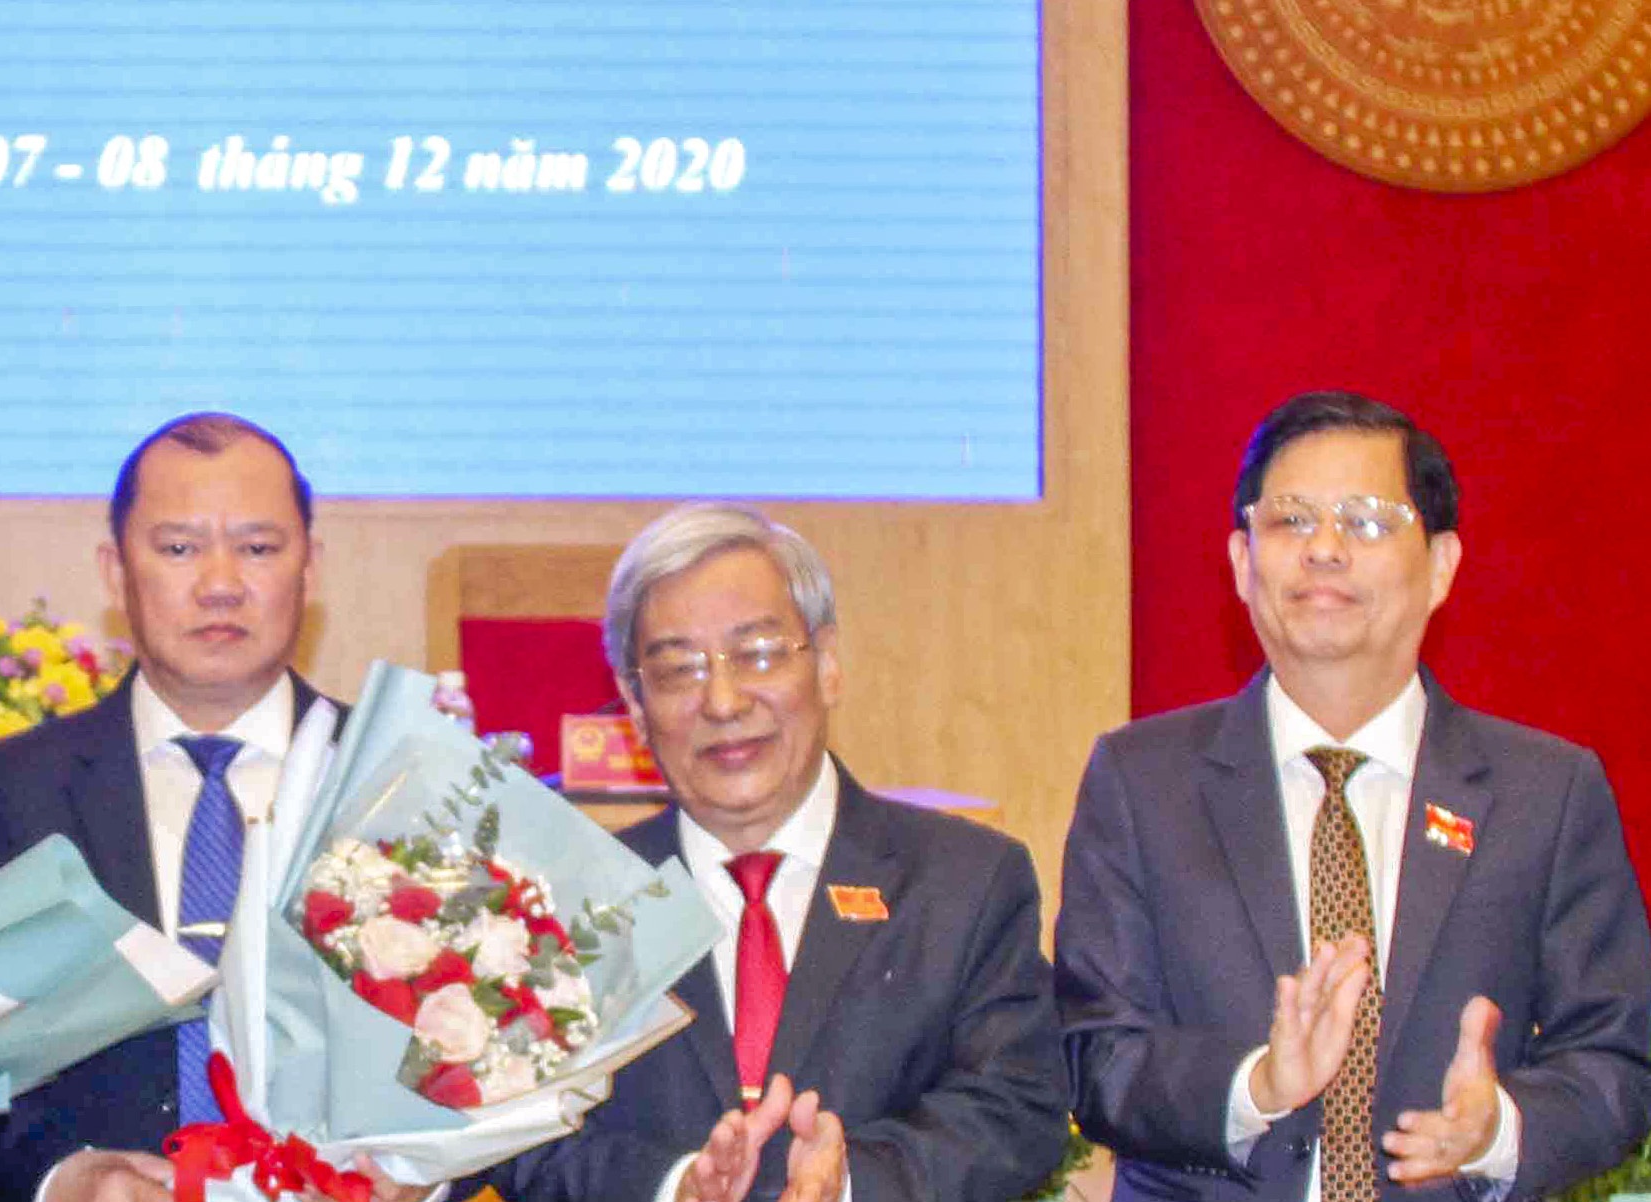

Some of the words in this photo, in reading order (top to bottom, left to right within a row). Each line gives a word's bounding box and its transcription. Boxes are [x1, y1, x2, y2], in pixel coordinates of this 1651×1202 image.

[96, 134, 170, 189] 08
[197, 134, 365, 205] tháng
[384, 135, 452, 190] 12
[462, 138, 590, 191] năm
[605, 136, 746, 192] 2020
